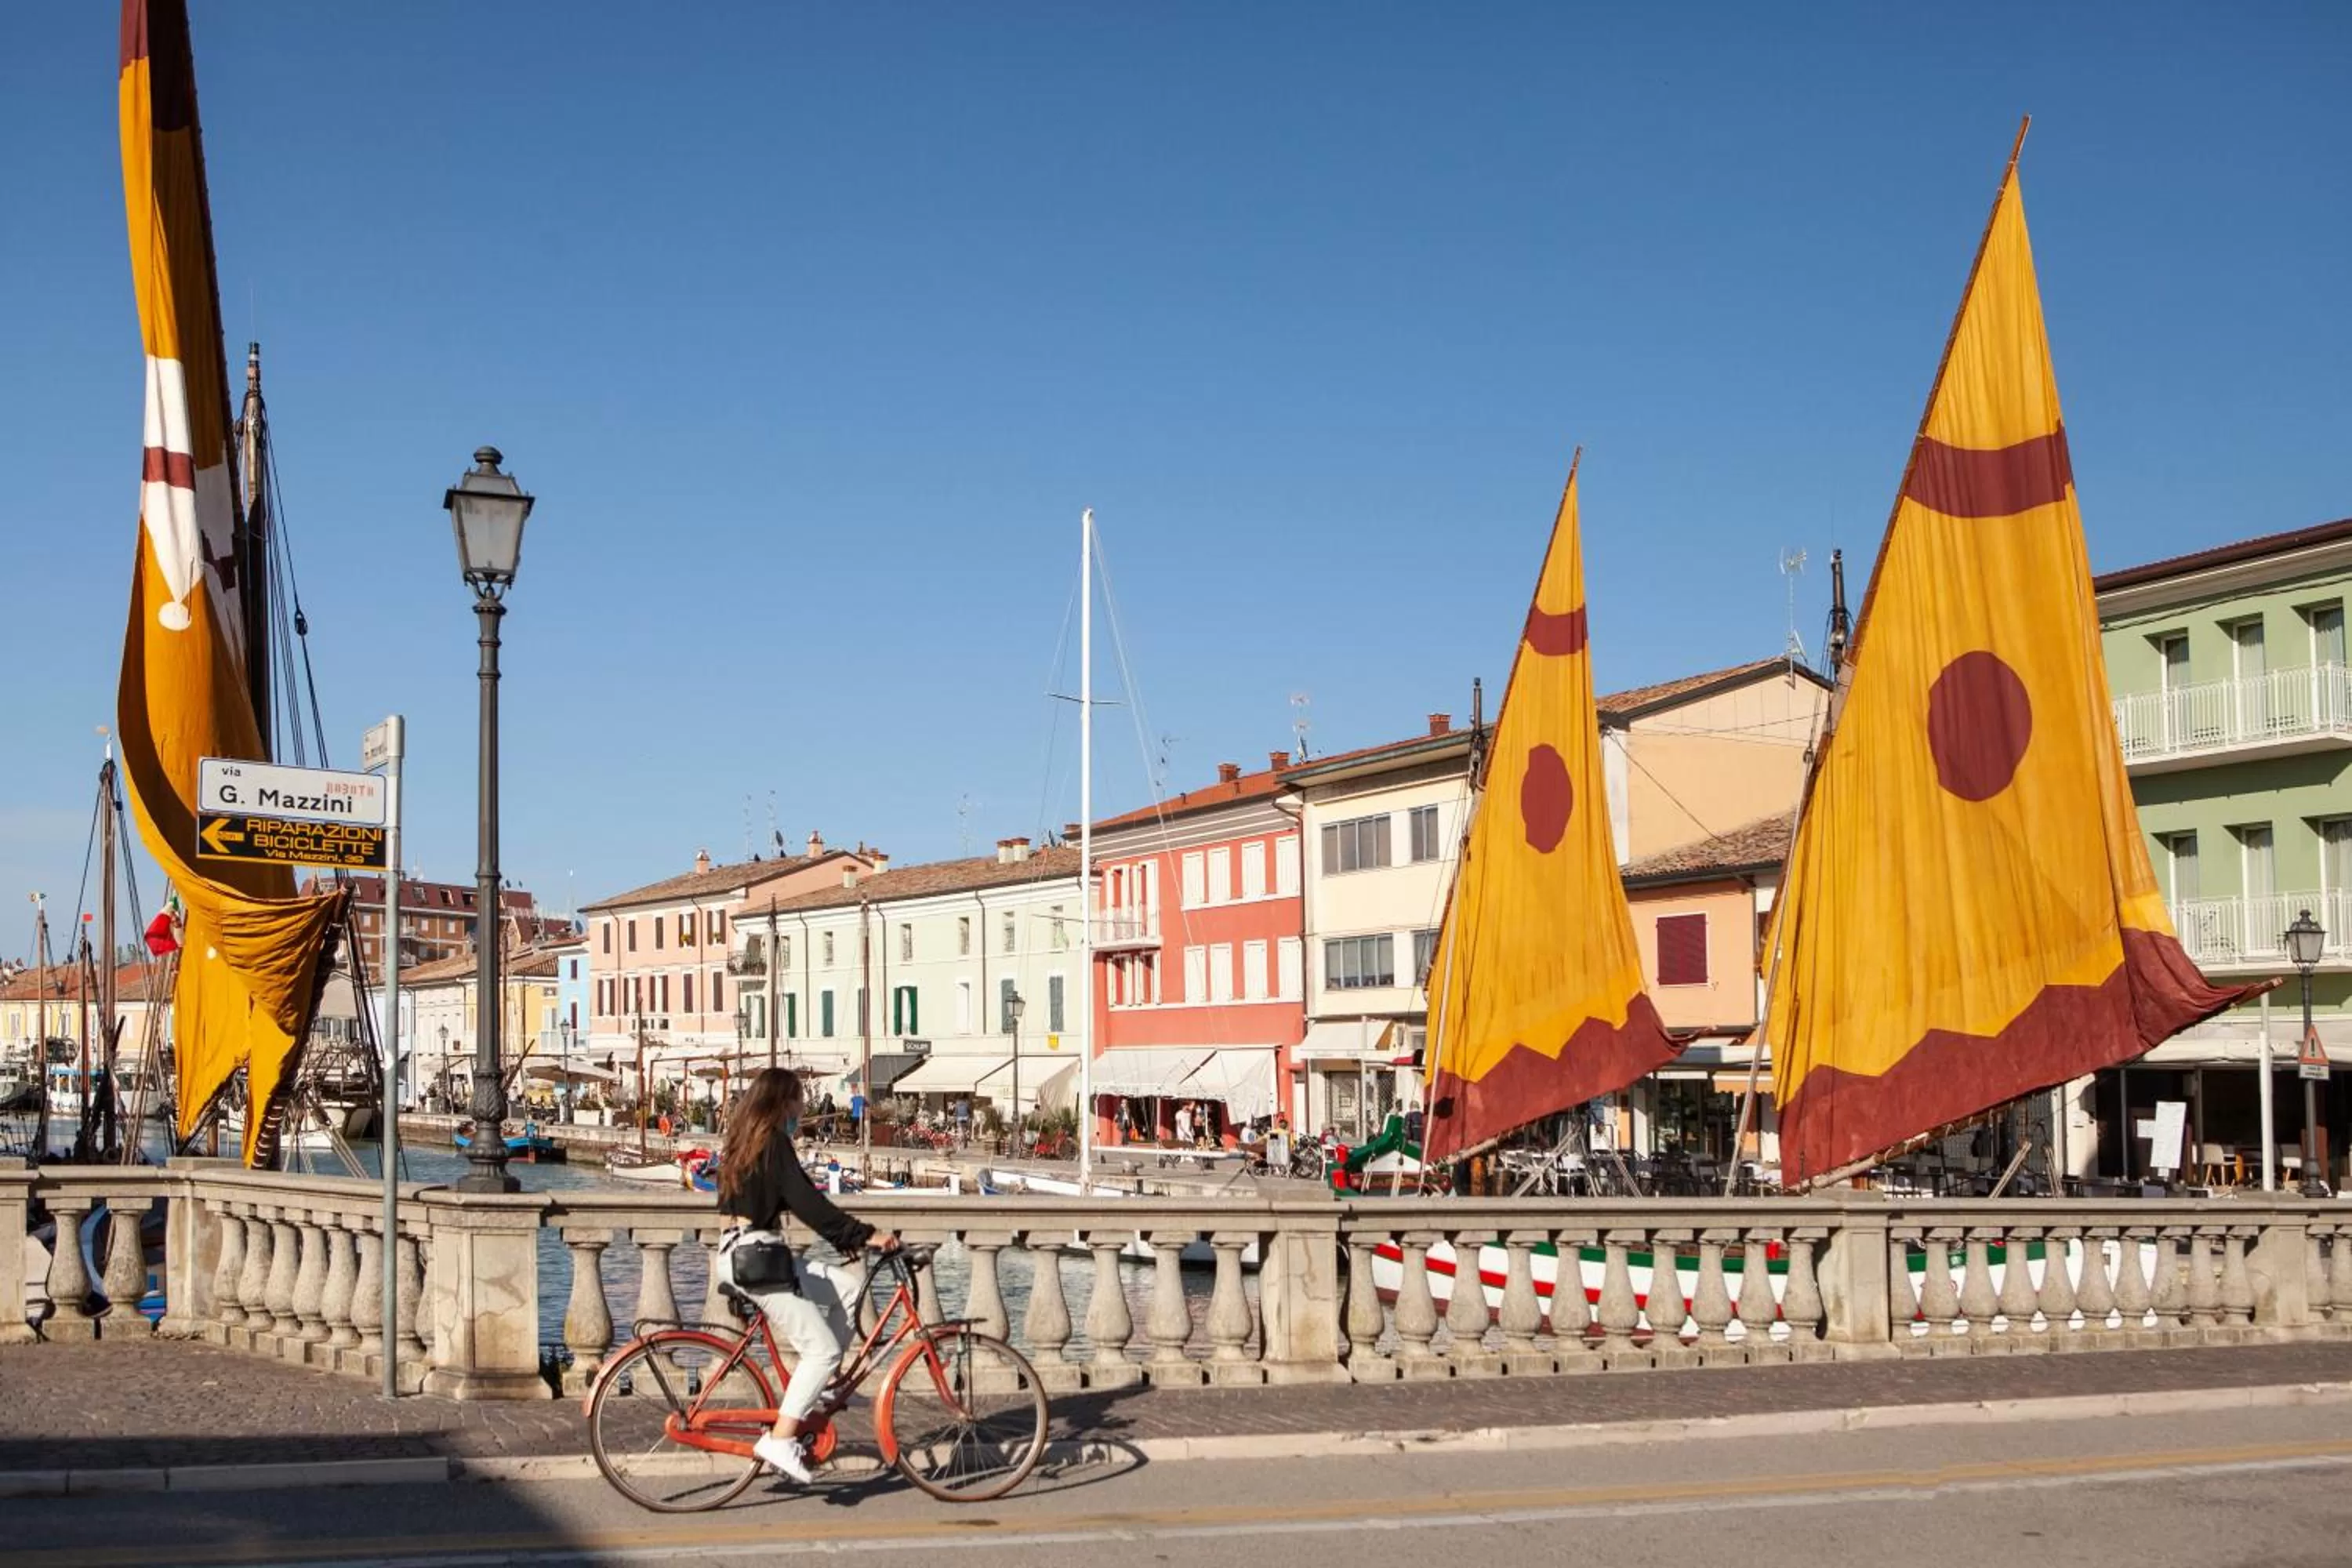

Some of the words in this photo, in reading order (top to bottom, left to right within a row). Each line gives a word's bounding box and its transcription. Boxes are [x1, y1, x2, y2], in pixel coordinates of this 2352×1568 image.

[222, 766, 241, 777] via
[219, 785, 245, 804] G.
[258, 787, 352, 813] Mazzini
[246, 818, 383, 841] RIPARAZIONI
[253, 833, 376, 856] BICICLETTE
[264, 848, 286, 858] Via
[289, 851, 342, 863] Mazzini,
